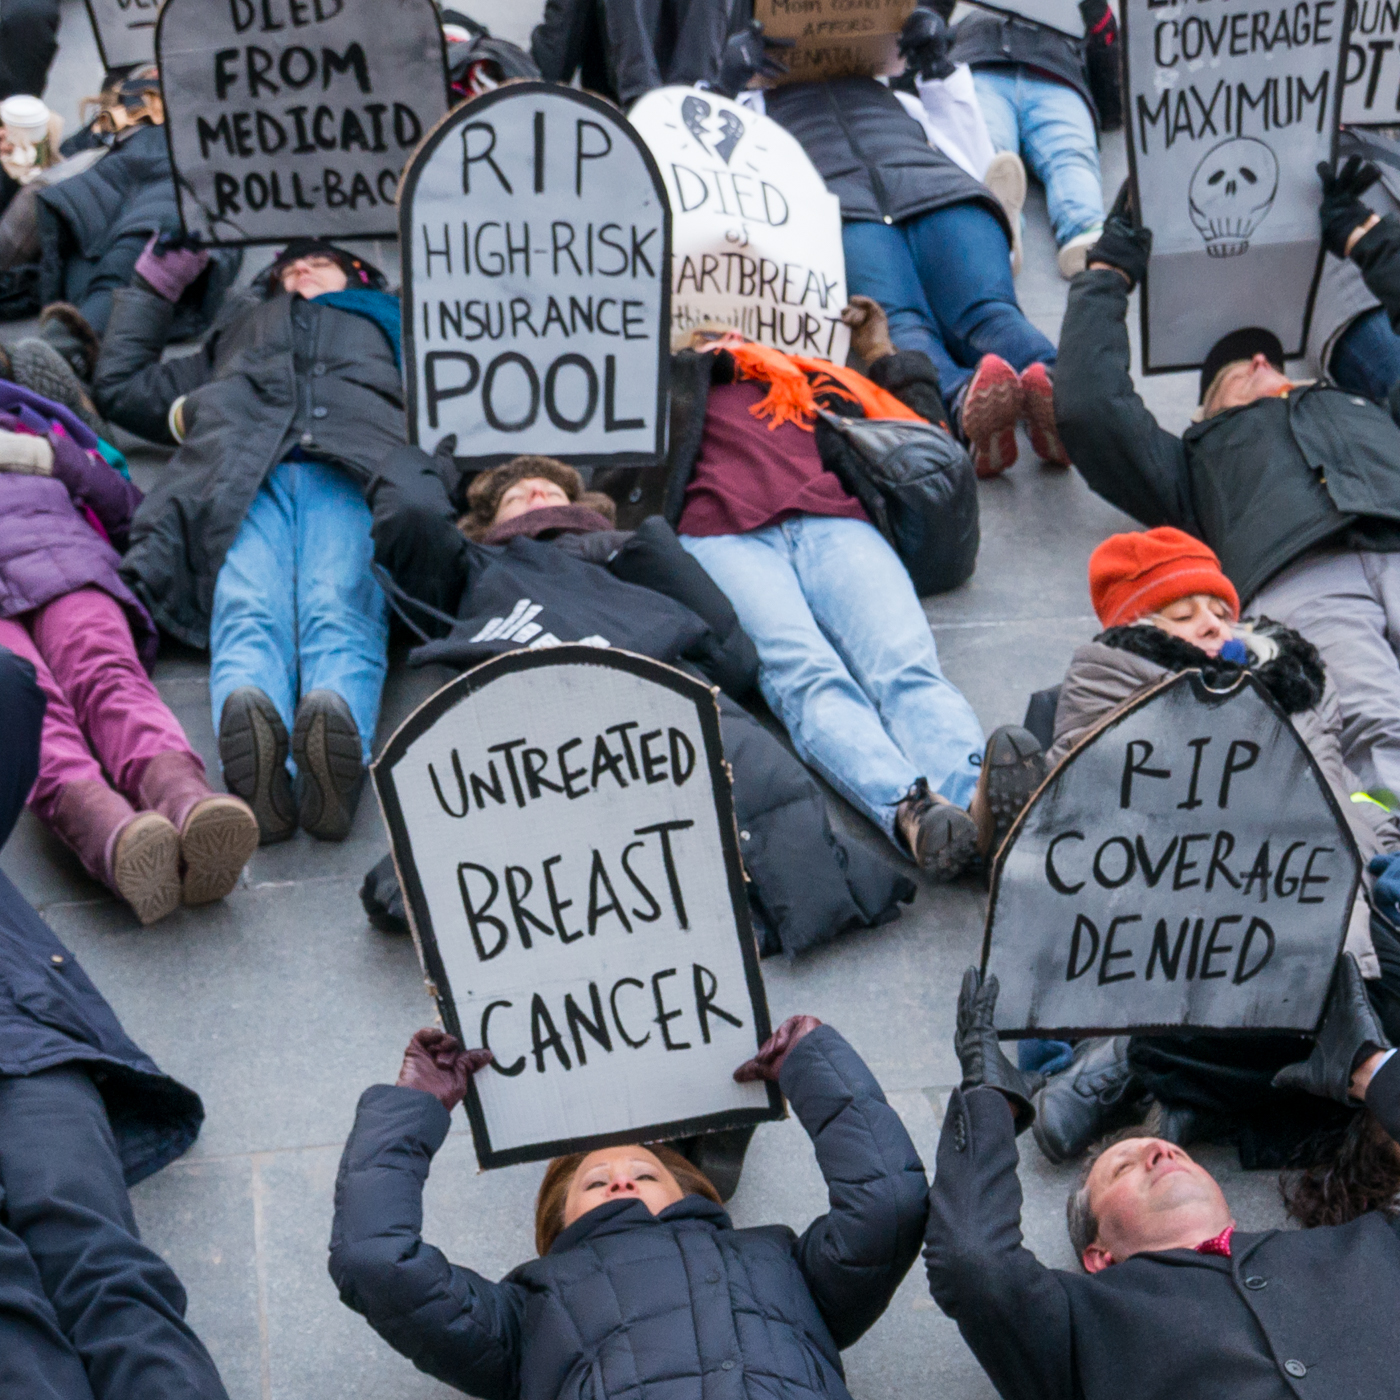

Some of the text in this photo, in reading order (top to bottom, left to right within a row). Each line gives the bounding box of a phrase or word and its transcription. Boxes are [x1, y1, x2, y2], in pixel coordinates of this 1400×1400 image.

[1154, 1, 1335, 68] COVERAGE
[214, 40, 372, 101] FROM
[197, 102, 422, 159] MEDICAID
[1136, 69, 1330, 156] MAXIMUM
[461, 110, 613, 197] RIP
[212, 167, 401, 217] ROLL-BAC
[671, 162, 789, 227] DIED
[422, 220, 658, 279] HIGH-RISK
[725, 222, 749, 248] of
[423, 295, 650, 342] INSURANCE
[756, 305, 844, 355] HURT
[424, 350, 648, 434] POOL
[428, 721, 697, 819] UNTREATED
[1120, 737, 1261, 809] RIP
[457, 819, 695, 961] BREAST
[1044, 830, 1335, 904] COVERAGE
[1066, 913, 1276, 987] DENIED
[480, 963, 744, 1077] CANCER
